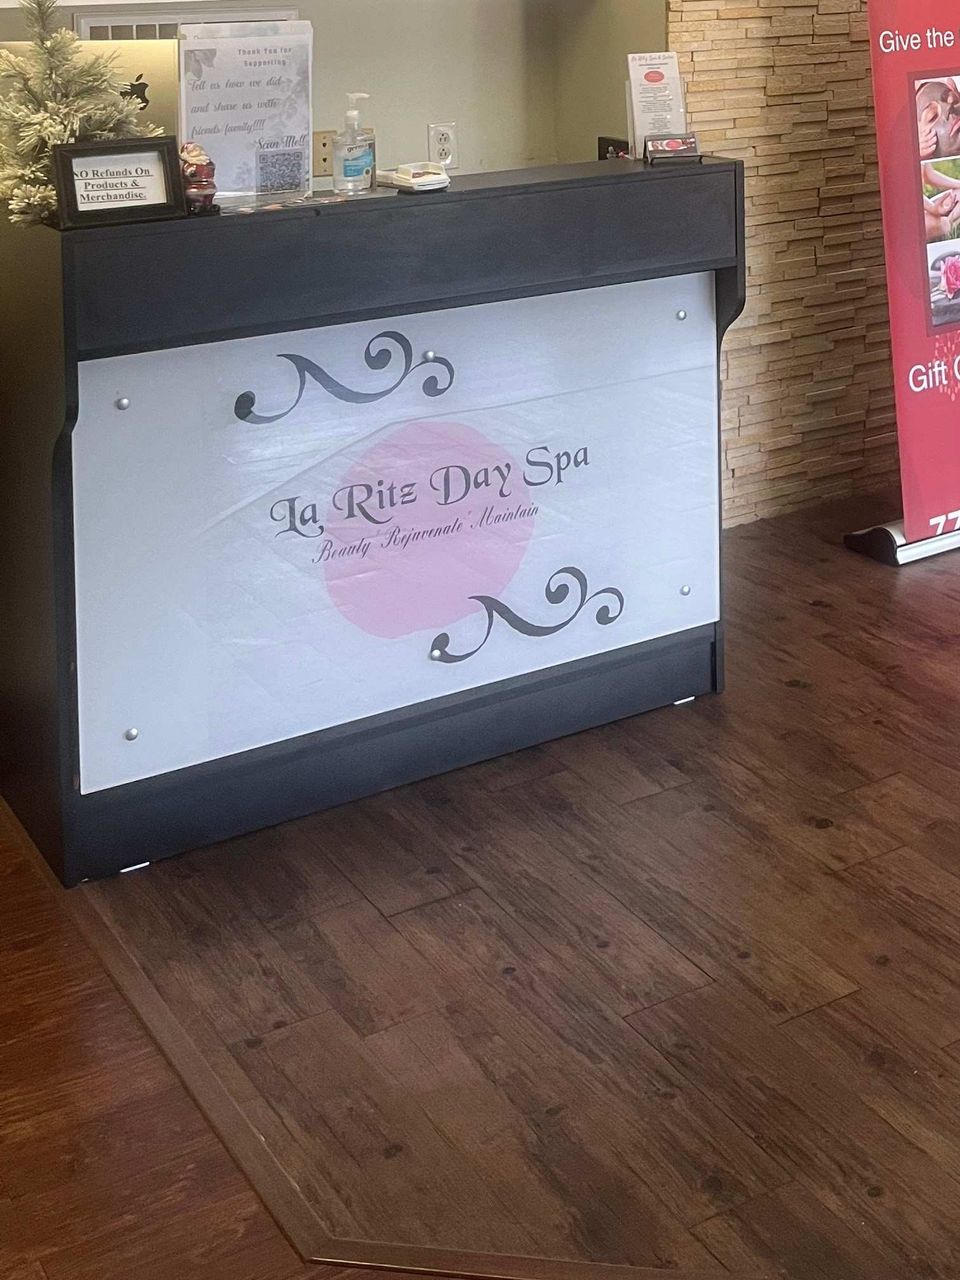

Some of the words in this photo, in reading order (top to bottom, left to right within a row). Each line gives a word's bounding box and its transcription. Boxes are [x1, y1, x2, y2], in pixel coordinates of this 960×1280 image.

[879, 30, 922, 53] Give
[927, 28, 954, 48] the
[238, 48, 261, 56] Thank
[188, 80, 207, 92] Tell
[210, 82, 220, 90] us
[225, 79, 244, 90] how
[266, 76, 283, 86] did
[190, 103, 208, 114] and
[214, 101, 237, 111] share
[257, 98, 280, 109] with
[190, 123, 220, 138] friends
[254, 138, 280, 150] Scan
[73, 170, 88, 178] NO
[92, 168, 132, 178] Refunds
[135, 166, 150, 175] On
[84, 180, 128, 190] Products
[131, 179, 140, 187] &
[80, 191, 146, 202] Merchandise.
[908, 360, 948, 392] Gift
[270, 496, 325, 539] La
[332, 479, 418, 524] Ritz
[430, 461, 512, 507] Day
[522, 446, 590, 488] Spa
[312, 539, 372, 564] Beauty
[380, 520, 464, 551] Rejuvenate
[470, 502, 540, 530] Maintain
